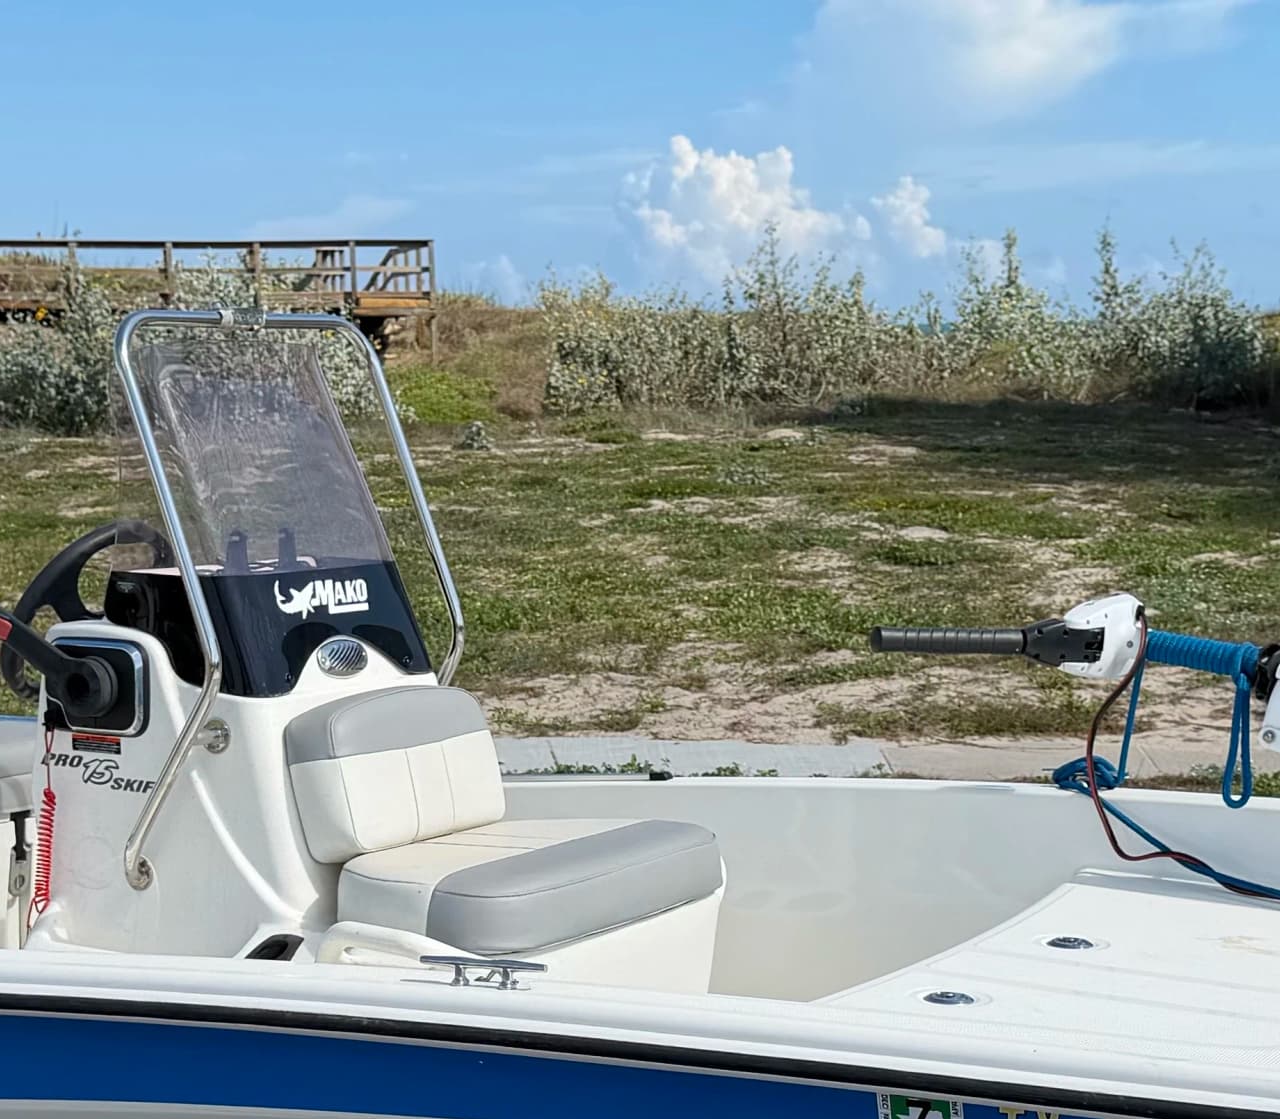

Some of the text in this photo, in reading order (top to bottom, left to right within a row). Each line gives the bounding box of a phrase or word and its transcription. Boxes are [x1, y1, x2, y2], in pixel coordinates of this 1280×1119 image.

[310, 578, 370, 615] MAKO
[41, 752, 157, 793] PRO 15 SKIF
